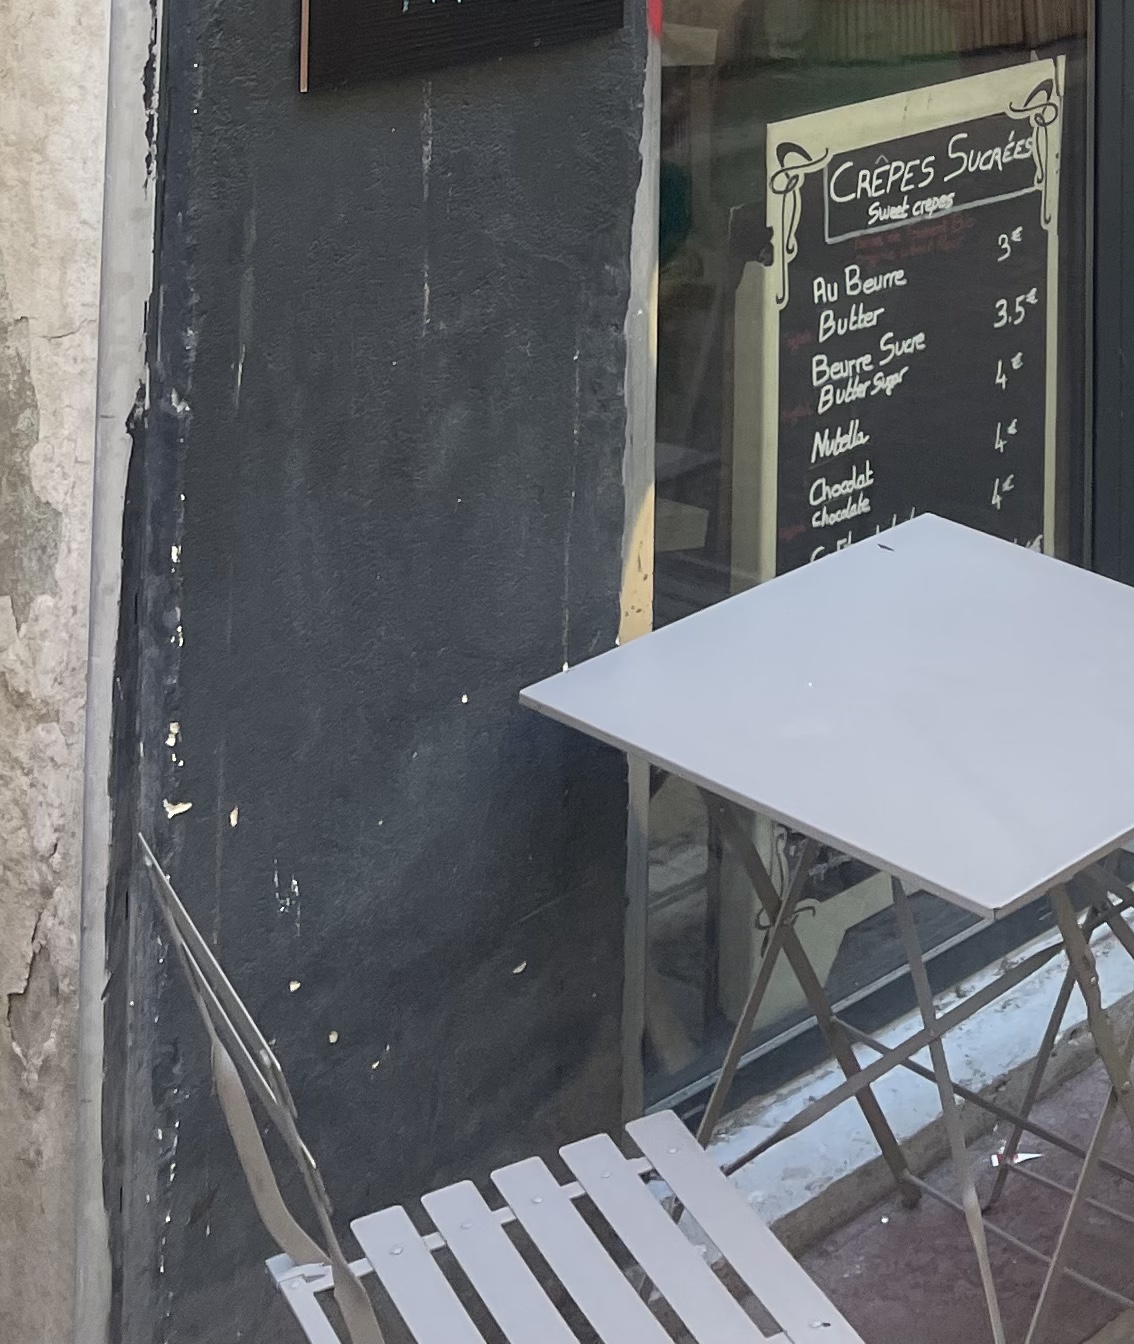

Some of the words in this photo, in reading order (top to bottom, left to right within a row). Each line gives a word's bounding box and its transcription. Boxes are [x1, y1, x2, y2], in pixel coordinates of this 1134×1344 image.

[829, 154, 935, 203] CRÊPES
[943, 131, 1034, 182] SUCRÉES
[867, 195, 909, 225] Sweet
[813, 276, 838, 304] Au
[844, 264, 907, 296] Beurre
[818, 302, 885, 343] Butter
[812, 354, 874, 387] Beurre
[879, 331, 926, 366] Sucre
[818, 374, 871, 414] Butter
[811, 419, 870, 463] Nutella
[809, 460, 874, 506] Chocolat
